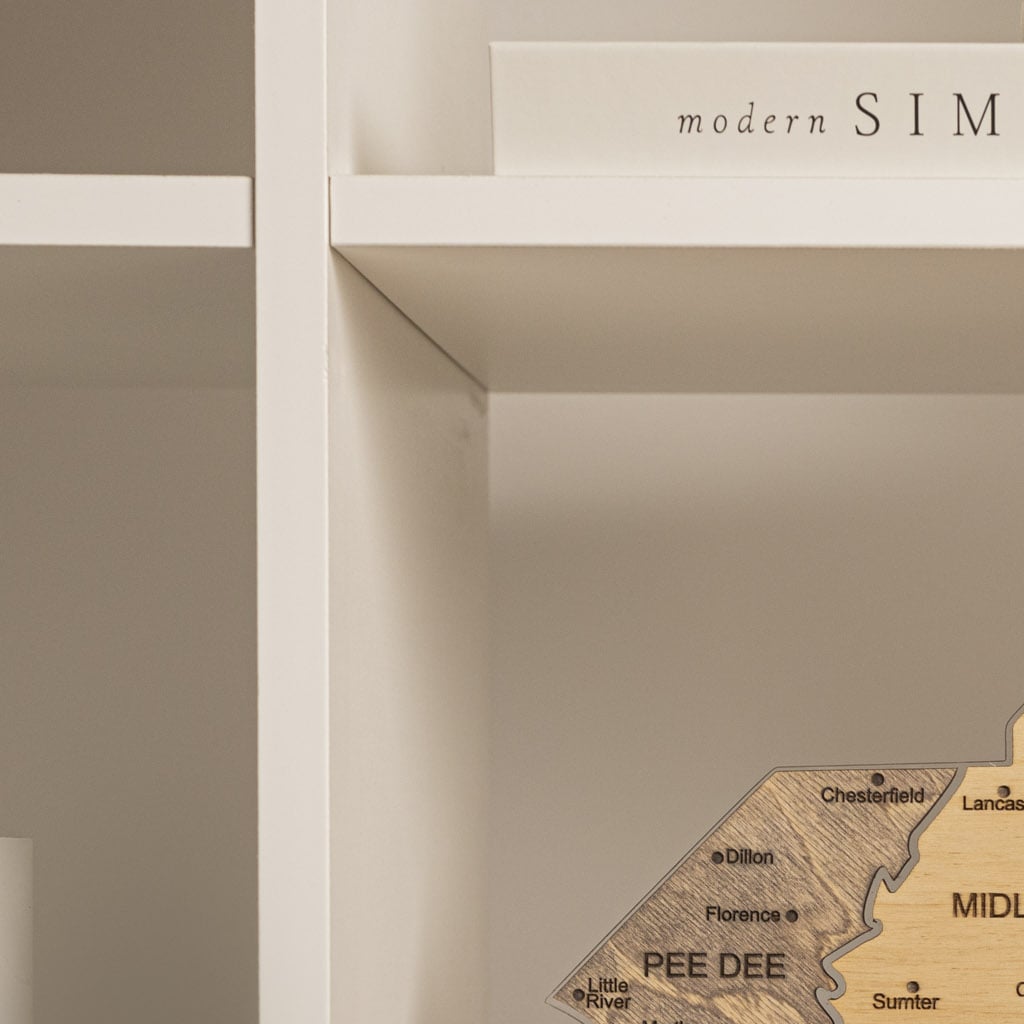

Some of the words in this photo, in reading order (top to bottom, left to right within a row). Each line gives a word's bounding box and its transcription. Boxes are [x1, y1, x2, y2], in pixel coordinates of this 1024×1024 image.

[677, 101, 828, 134] modern
[821, 787, 925, 804] Chesterfield
[726, 849, 774, 865] Dillon
[706, 907, 781, 923] Florence
[643, 952, 708, 979] PEE
[719, 953, 786, 979] DEE
[588, 978, 629, 993] Little
[586, 994, 631, 1009] River
[873, 993, 939, 1010] Sumter
